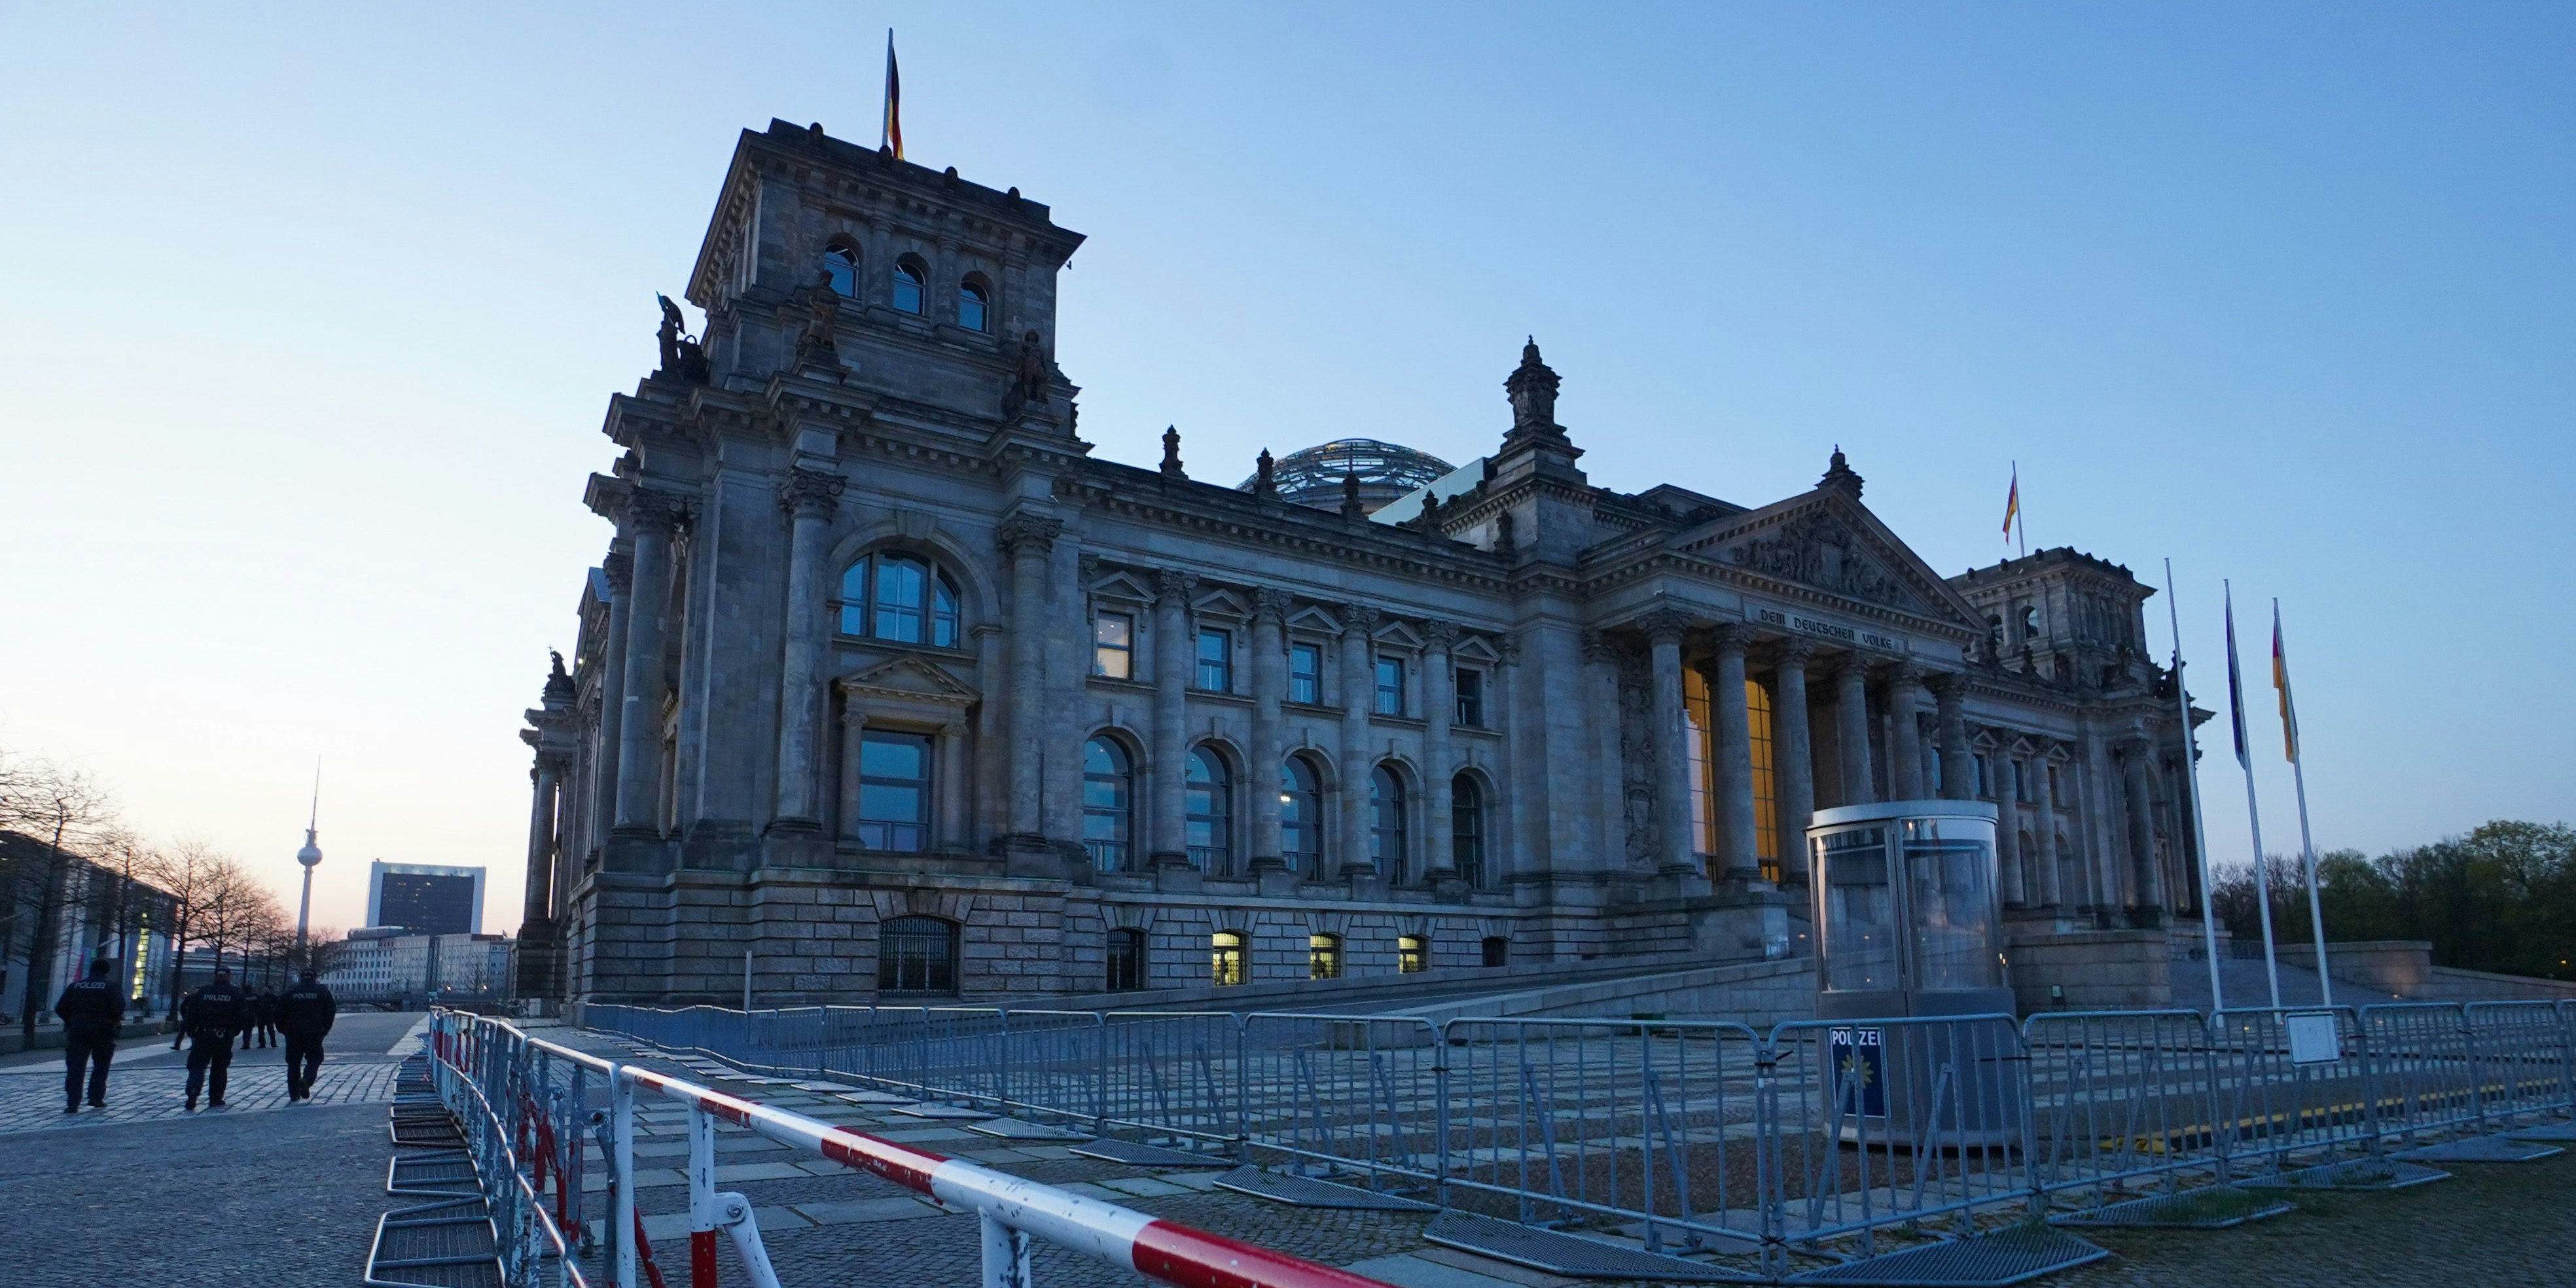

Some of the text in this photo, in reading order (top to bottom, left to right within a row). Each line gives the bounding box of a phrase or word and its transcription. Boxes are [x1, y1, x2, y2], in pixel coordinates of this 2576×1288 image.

[1761, 609, 1891, 649] DEM DEUTSCHEN VOLKE
[1833, 1031, 1880, 1045] POLZEI
